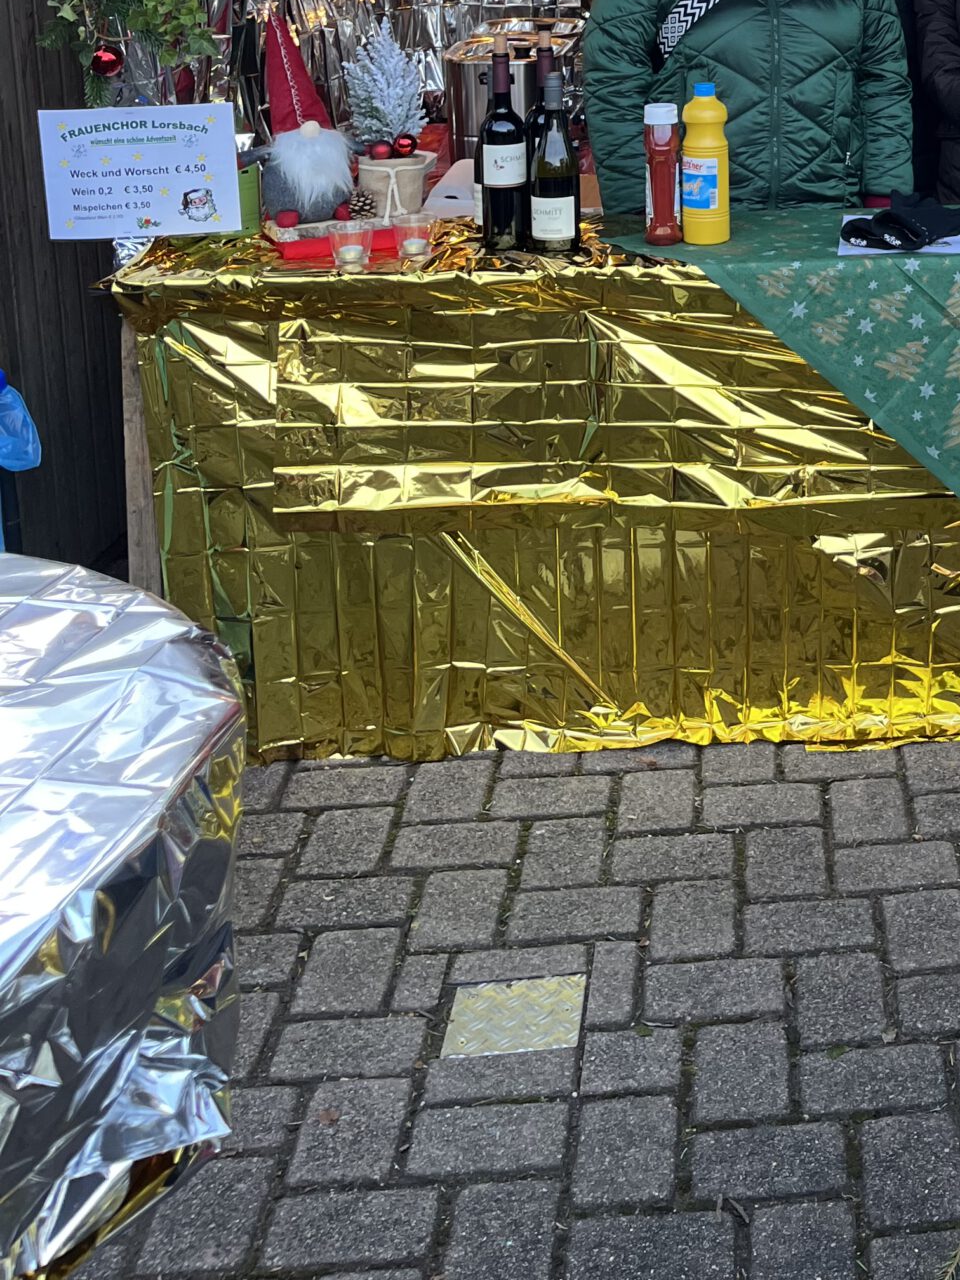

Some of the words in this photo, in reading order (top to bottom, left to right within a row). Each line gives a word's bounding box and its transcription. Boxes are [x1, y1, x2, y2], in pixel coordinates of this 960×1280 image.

[60, 120, 148, 142] FRAUENCHOR
[151, 120, 209, 134] Lorsbach
[70, 169, 99, 178] Weck
[101, 168, 121, 177] und
[124, 166, 170, 176] Worscht
[175, 164, 182, 174] €
[184, 163, 206, 174] 4,50
[71, 187, 96, 196] Wein
[98, 186, 113, 196] 0,2
[124, 185, 131, 194] €
[133, 184, 153, 194] 3,50
[73, 203, 123, 213] Mispelchen
[125, 201, 131, 210] €
[133, 200, 151, 210] 3,50
